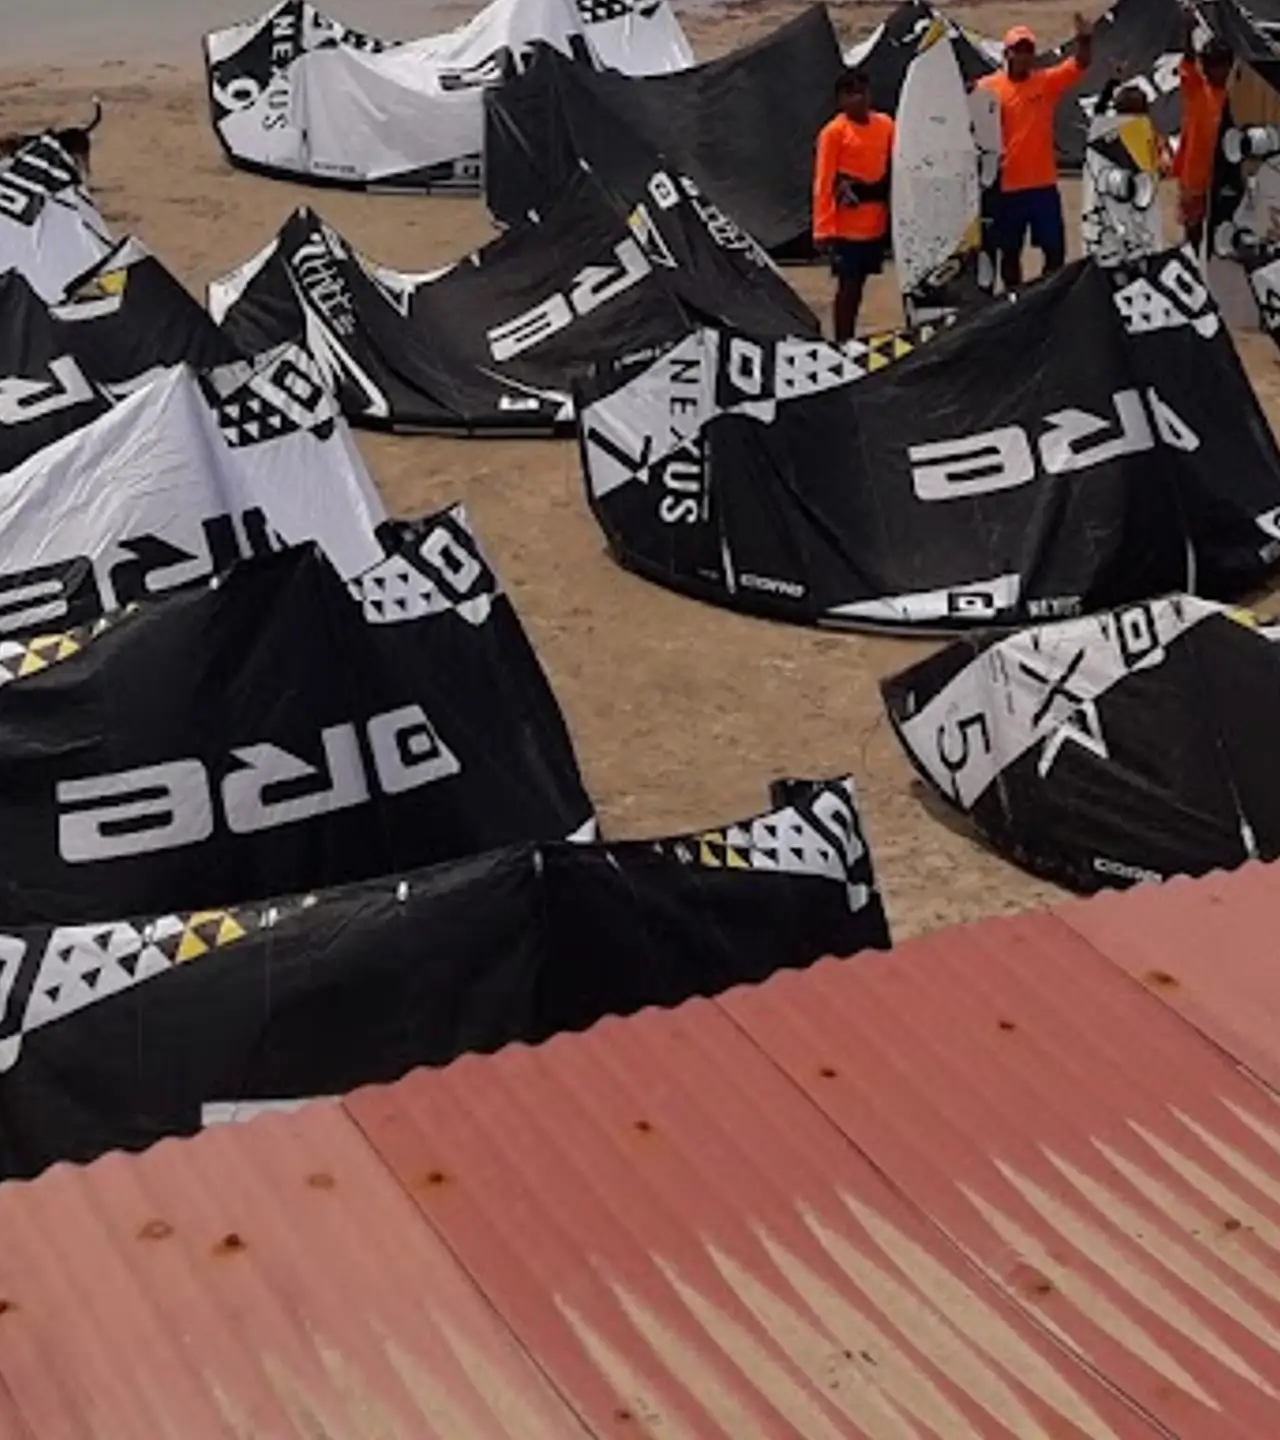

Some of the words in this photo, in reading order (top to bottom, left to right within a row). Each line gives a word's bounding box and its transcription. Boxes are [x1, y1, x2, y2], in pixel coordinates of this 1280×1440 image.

[487, 236, 652, 363] RE
[658, 359, 703, 524] NEXUS
[936, 711, 991, 772] 5
